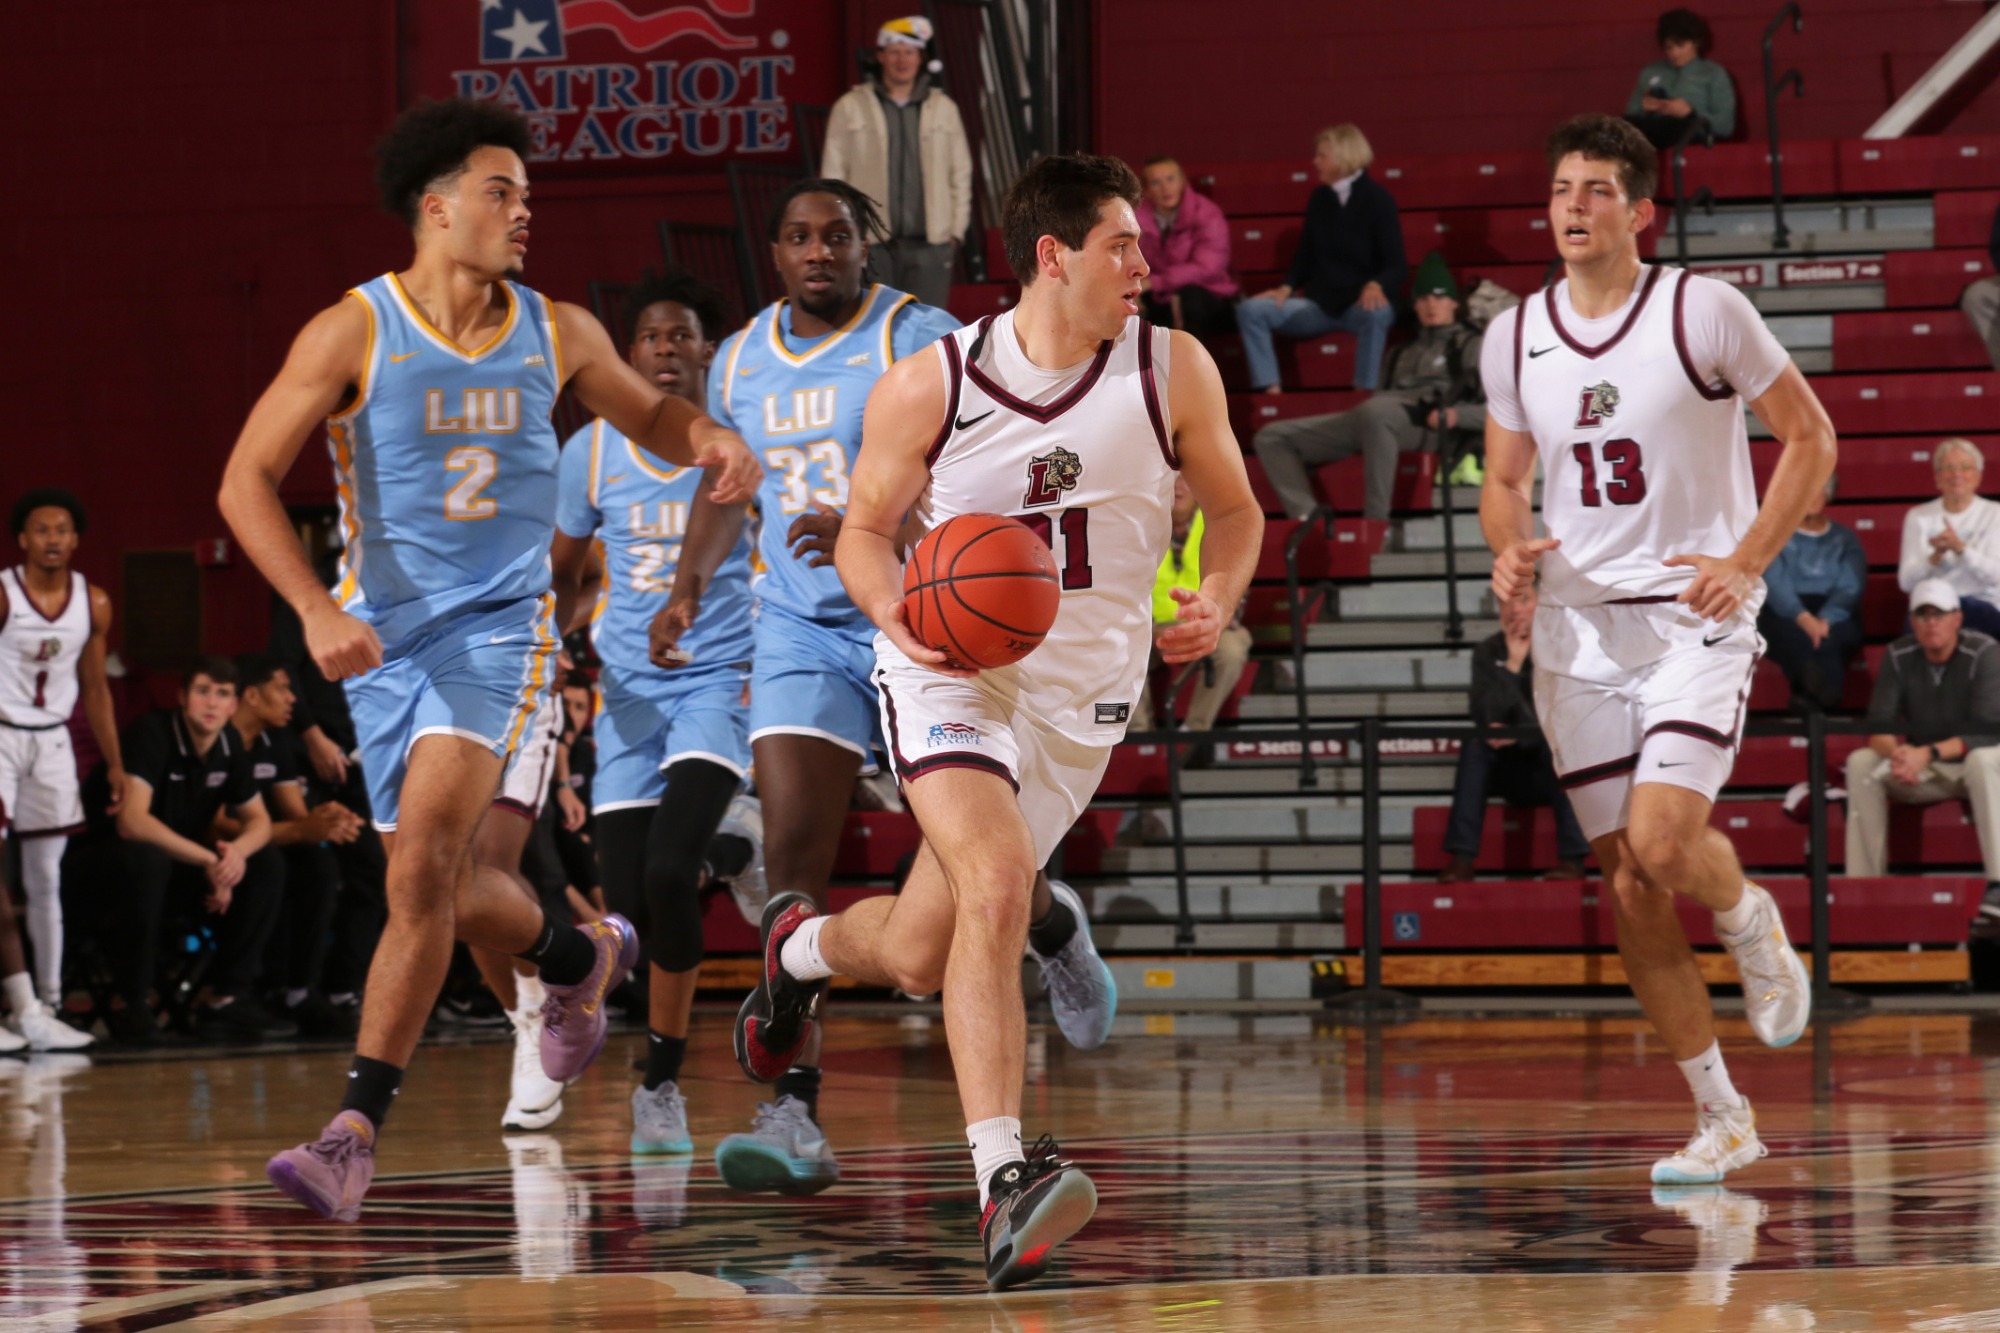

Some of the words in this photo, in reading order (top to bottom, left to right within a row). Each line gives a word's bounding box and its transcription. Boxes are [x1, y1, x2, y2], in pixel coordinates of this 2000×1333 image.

[451, 56, 795, 114] PATRIOT
[527, 105, 793, 163] EAGUE
[1745, 266, 1759, 283] 6
[1783, 265, 1844, 282] Section
[1847, 262, 1859, 279] 7
[425, 387, 521, 434] LIU
[764, 386, 837, 435] LIU
[444, 446, 498, 521] 2
[765, 439, 850, 514] 33
[1023, 460, 1062, 508] L
[1572, 438, 1647, 507] 13
[33, 670, 48, 709] 1
[1118, 709, 1126, 718] XL
[927, 733, 981, 743] PATRIOT
[927, 738, 982, 748] LEAGUE
[1259, 740, 1324, 755] Sectin
[1378, 738, 1433, 754] ection
[1436, 738, 1448, 752] 7
